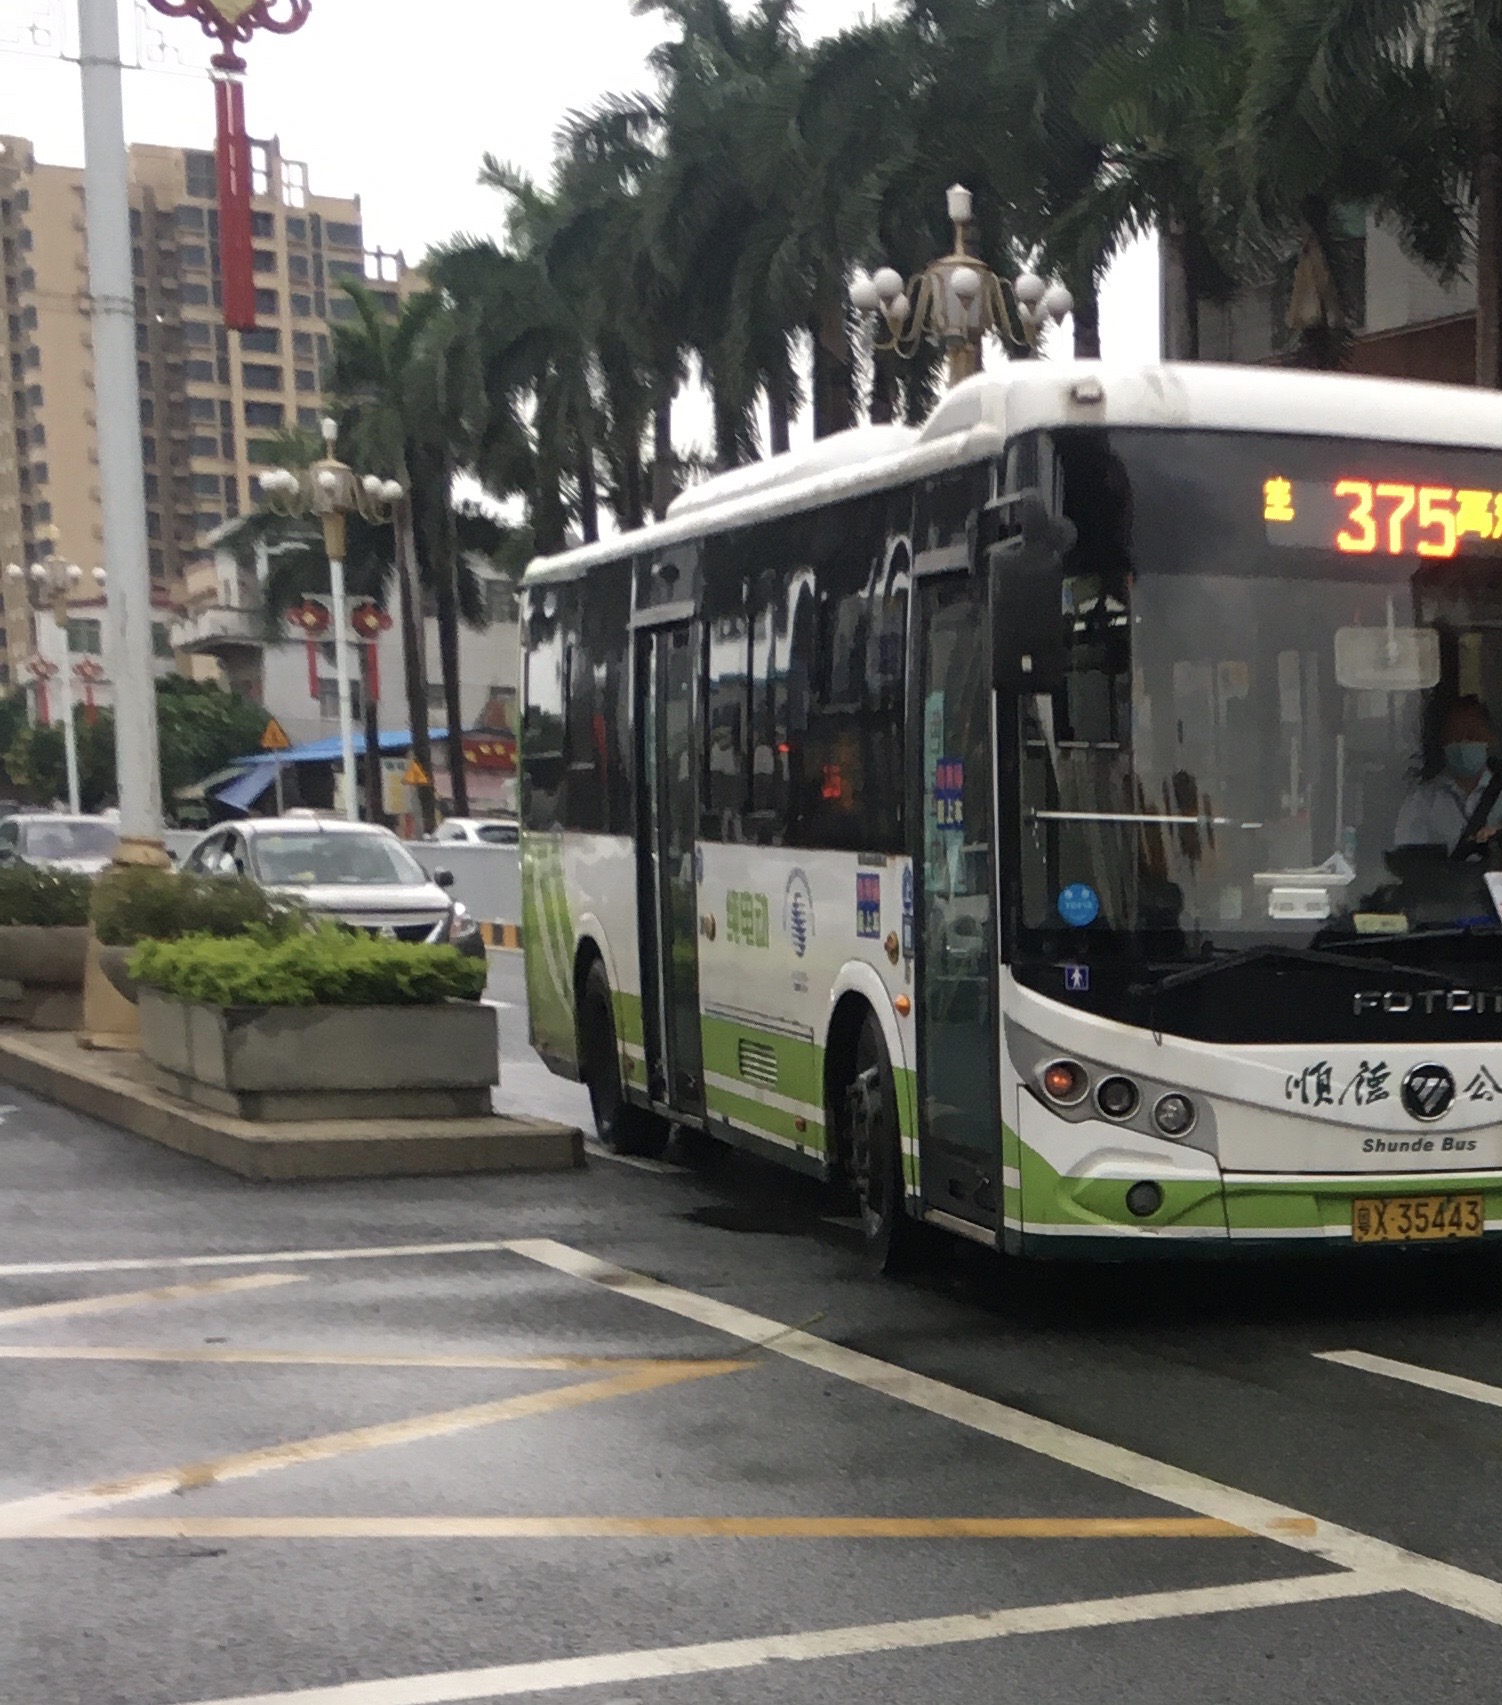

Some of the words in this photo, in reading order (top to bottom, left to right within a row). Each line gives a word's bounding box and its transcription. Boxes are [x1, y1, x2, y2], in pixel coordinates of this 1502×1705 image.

[1334, 479, 1457, 557] 375
[1362, 1137, 1434, 1153] Shunde
[1440, 1136, 1478, 1152] Bus
